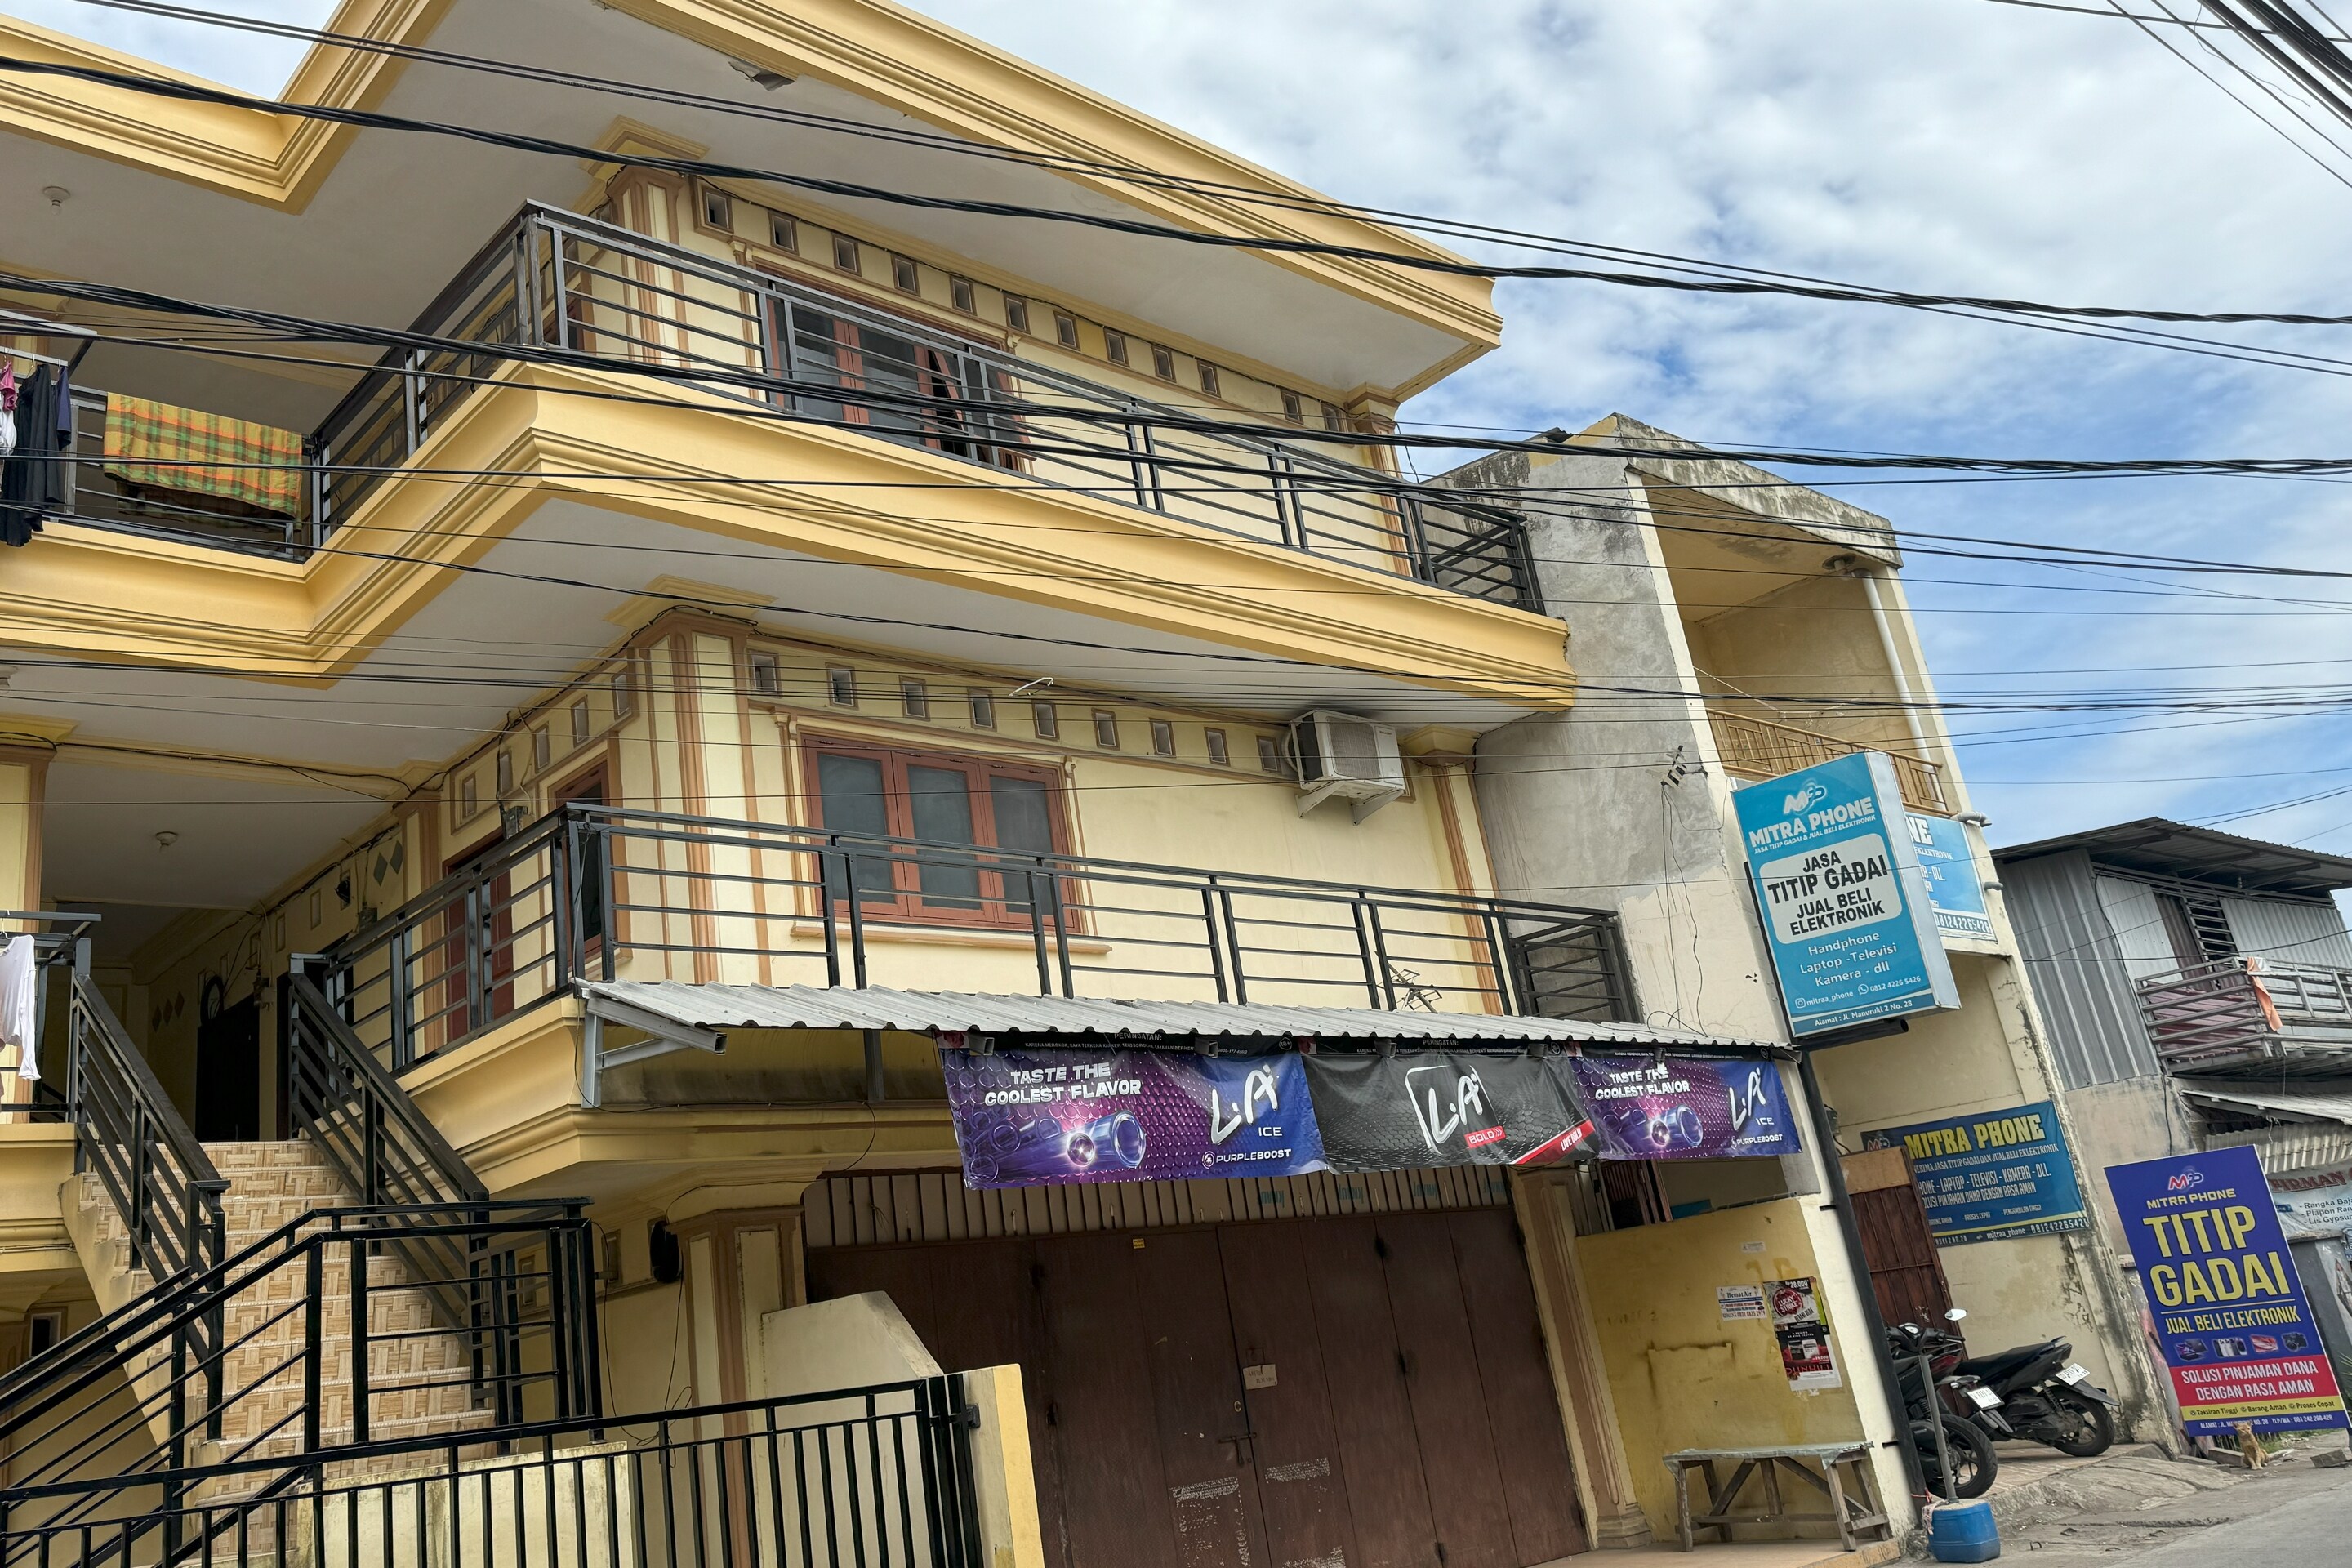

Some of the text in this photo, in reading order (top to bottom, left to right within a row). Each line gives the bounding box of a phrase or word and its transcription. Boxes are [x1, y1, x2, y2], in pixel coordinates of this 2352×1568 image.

[1748, 796, 1875, 847] MITRA PHONE
[1754, 845, 1769, 854] JASA
[1770, 841, 1783, 850] TITIP
[1784, 836, 1803, 846] GADAI
[1809, 831, 1824, 840] JUAL
[1838, 815, 1876, 831] ELEKTRONIK
[1802, 851, 1842, 873] JASA
[1767, 873, 1818, 904] TITIP
[1824, 854, 1888, 889] GADAI
[1797, 887, 1872, 918] JUAL BELI
[1789, 900, 1885, 935] ELEKTRONIK
[1808, 933, 1880, 956] Handphone
[1800, 957, 1842, 973] Laptop
[1815, 969, 1862, 987] Kamera
[1873, 960, 1890, 973] dll
[1806, 975, 1921, 1006] mitraa_phone 0812 4226 5426
[1815, 1018, 1838, 1027] Alamat
[1851, 1005, 1883, 1018] Manuruki
[1890, 1002, 1903, 1010] No.
[1010, 1062, 1111, 1085] TASTE THE
[1609, 1067, 1668, 1084] TASTE THE
[984, 1080, 1142, 1106] COOLEST FLAVOR
[1595, 1080, 1690, 1100] COOLEST FLAVOR
[1258, 1127, 1283, 1137] ICE
[1756, 1117, 1775, 1125] ICE
[1468, 1131, 1495, 1146] BOLD
[1560, 1129, 1583, 1152] LIVE BOLD
[1736, 1134, 1783, 1146] PURPLEBOOST
[1904, 1113, 2046, 1160] MITRA PHONE
[1215, 1149, 1292, 1164] PURPLEBOOST
[1934, 1160, 1948, 1171] JASA
[1948, 1157, 1962, 1169] TITIP
[1962, 1155, 1980, 1166] GADAI
[1980, 1153, 1992, 1164] DAN
[1992, 1151, 2006, 1162] JUAL
[2006, 1148, 2019, 1160] BELI
[2019, 1143, 2059, 1157] EKLEKTRONIK
[1940, 1175, 1965, 1192] LAPTOP
[1969, 1170, 1998, 1188] TELEVISI
[2002, 1165, 2032, 1183] KAMERA
[2035, 1163, 2051, 1178] DLL.
[2270, 1170, 2347, 1192] FIRMAN
[1938, 1192, 1966, 1206] PINJAMAN
[1966, 1191, 1982, 1202] DANA
[1981, 1187, 2002, 1201] DENGAN
[2003, 1184, 2019, 1197] RASA
[2019, 1181, 2037, 1195] AMAN
[2146, 1188, 2236, 1209] MITRA PHONE
[2304, 1200, 2335, 1210] Rangka
[2306, 1209, 2336, 1218] Plapon
[1986, 1227, 2025, 1240] mitraa_phone
[2143, 1205, 2256, 1258] TITIP
[2149, 1251, 2291, 1307] GADAI
[1778, 1294, 1794, 1307] LUCKY
[1780, 1303, 1798, 1313] STRIKE
[2165, 1306, 2302, 1334] JUAL BELI ELEKTRONIK
[2180, 1360, 2319, 1384] SOLUSI PINJAMAN DANA
[2195, 1379, 2315, 1401] DENGAN RASA AMAN
[2247, 1405, 2269, 1414] Barang
[2296, 1401, 2317, 1410] Proses
